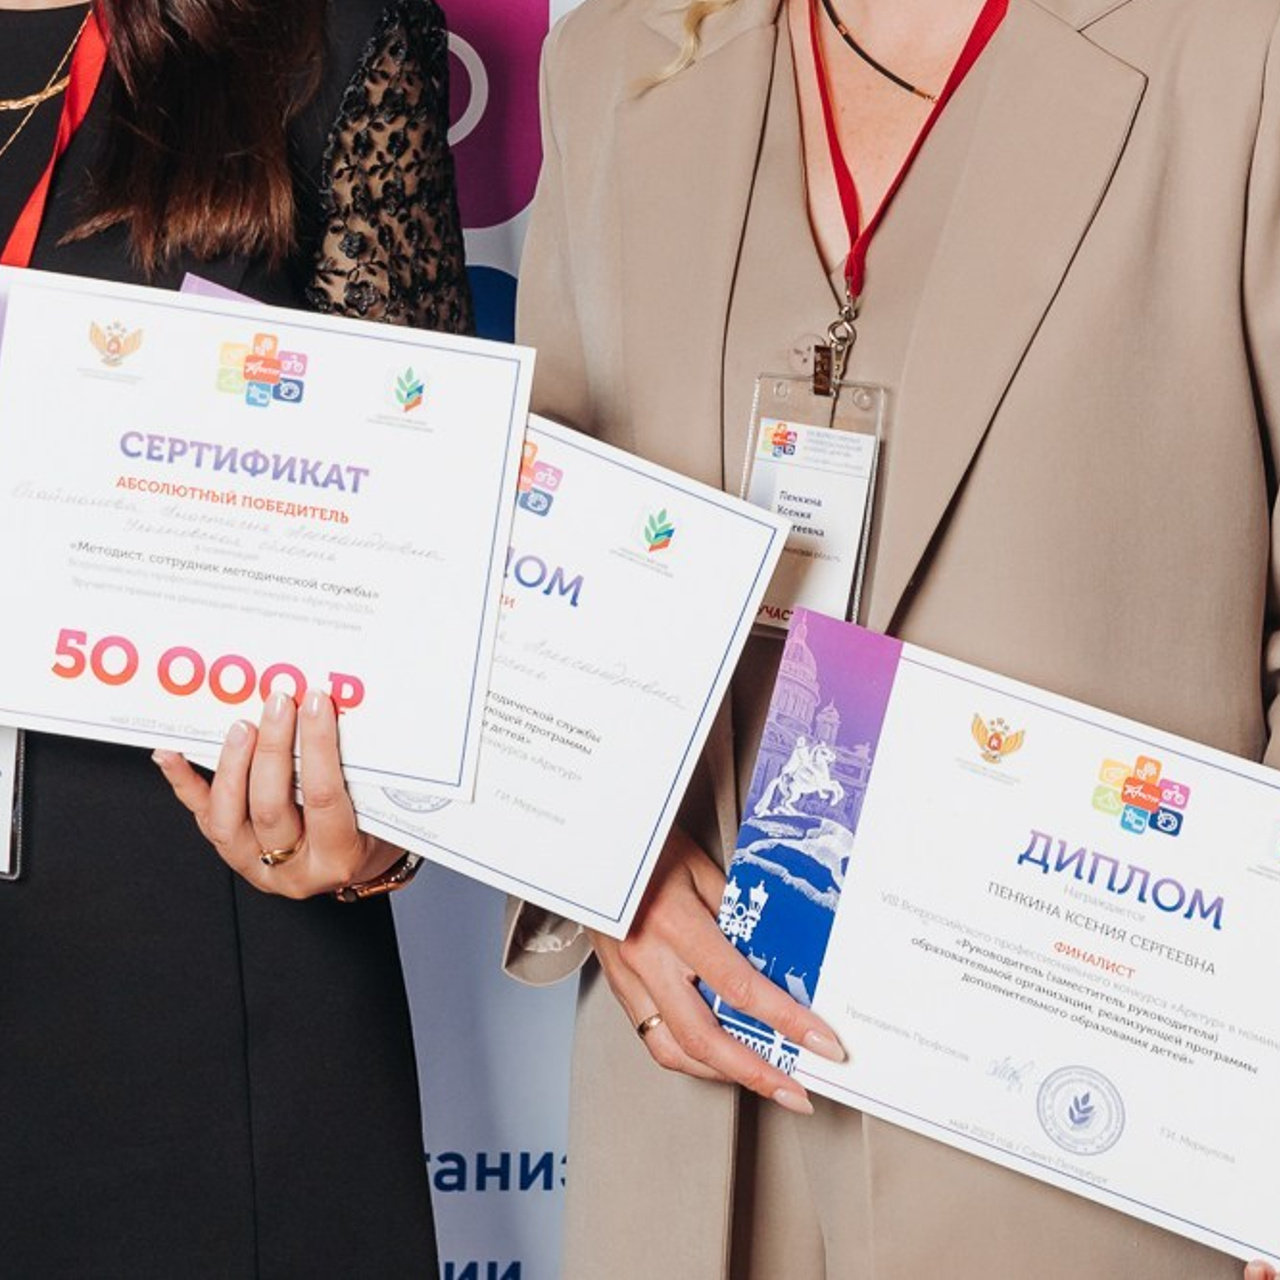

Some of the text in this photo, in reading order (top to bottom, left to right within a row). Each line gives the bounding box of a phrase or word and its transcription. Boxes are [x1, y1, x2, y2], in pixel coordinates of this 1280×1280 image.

[115, 475, 350, 524] АБСОЛЮТНЫЙ ПОБЕДИТЕЛЬ
[120, 430, 370, 493] СЕРТИФИКАТ
[149, 552, 220, 574] сотрудник
[222, 566, 318, 589] методической
[320, 581, 380, 599] службы»
[52, 628, 139, 686] 50
[156, 645, 308, 710] 000
[524, 721, 593, 755] программы
[1017, 828, 1225, 932] ДИПЛОМ
[988, 881, 1216, 975] ПЕНКИНА КСЕНИЯ СЕРГЕЕВНА
[1053, 941, 1137, 979] ФИНАЛИСТ
[910, 936, 1013, 982] образовательной
[1097, 1008, 1183, 1047] реализующей
[1184, 1038, 1259, 1075] программы
[955, 937, 1219, 1045] «Руководитель (заместитель руководителя)
[961, 971, 1068, 1019] дополнительного
[1070, 1013, 1149, 1050] образования
